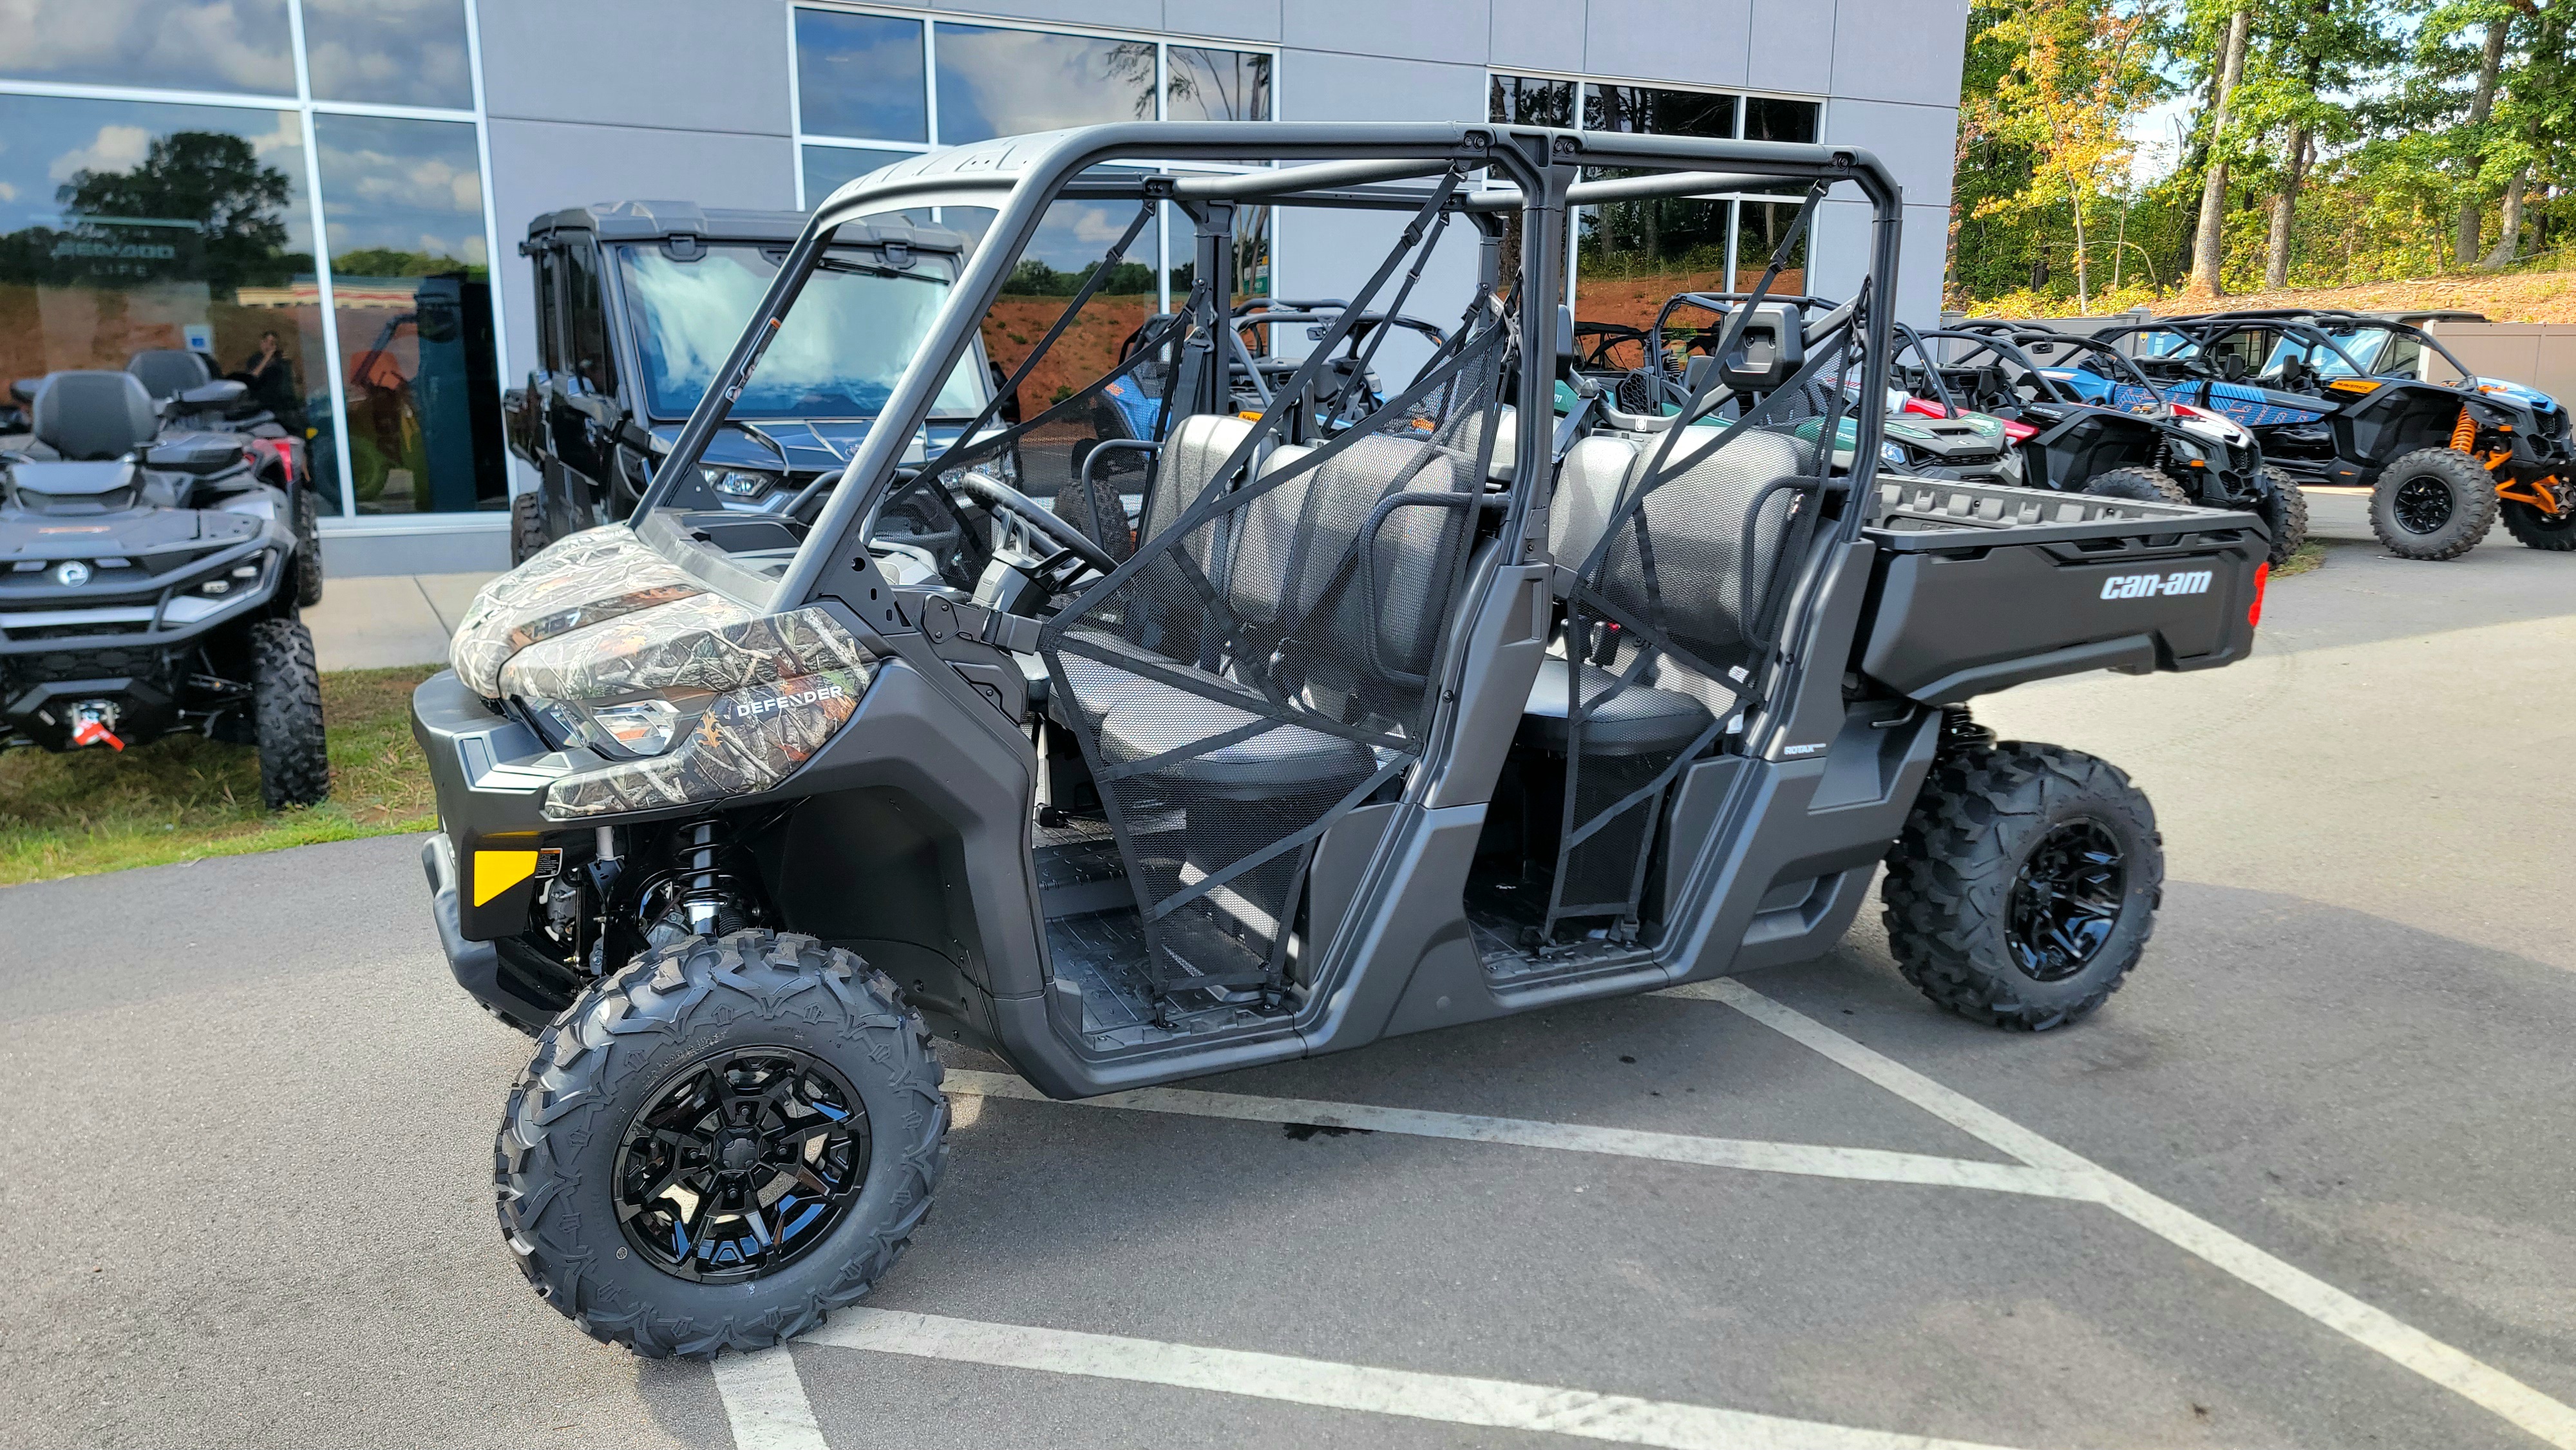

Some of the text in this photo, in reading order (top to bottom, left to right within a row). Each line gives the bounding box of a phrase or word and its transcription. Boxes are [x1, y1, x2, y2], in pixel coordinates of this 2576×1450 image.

[2030, 406, 2063, 417] MAVERICK
[2099, 570, 2213, 599] can-am
[533, 611, 582, 638] HD7
[737, 685, 843, 717] DEFENDER
[1784, 744, 1826, 755] ROTAX
